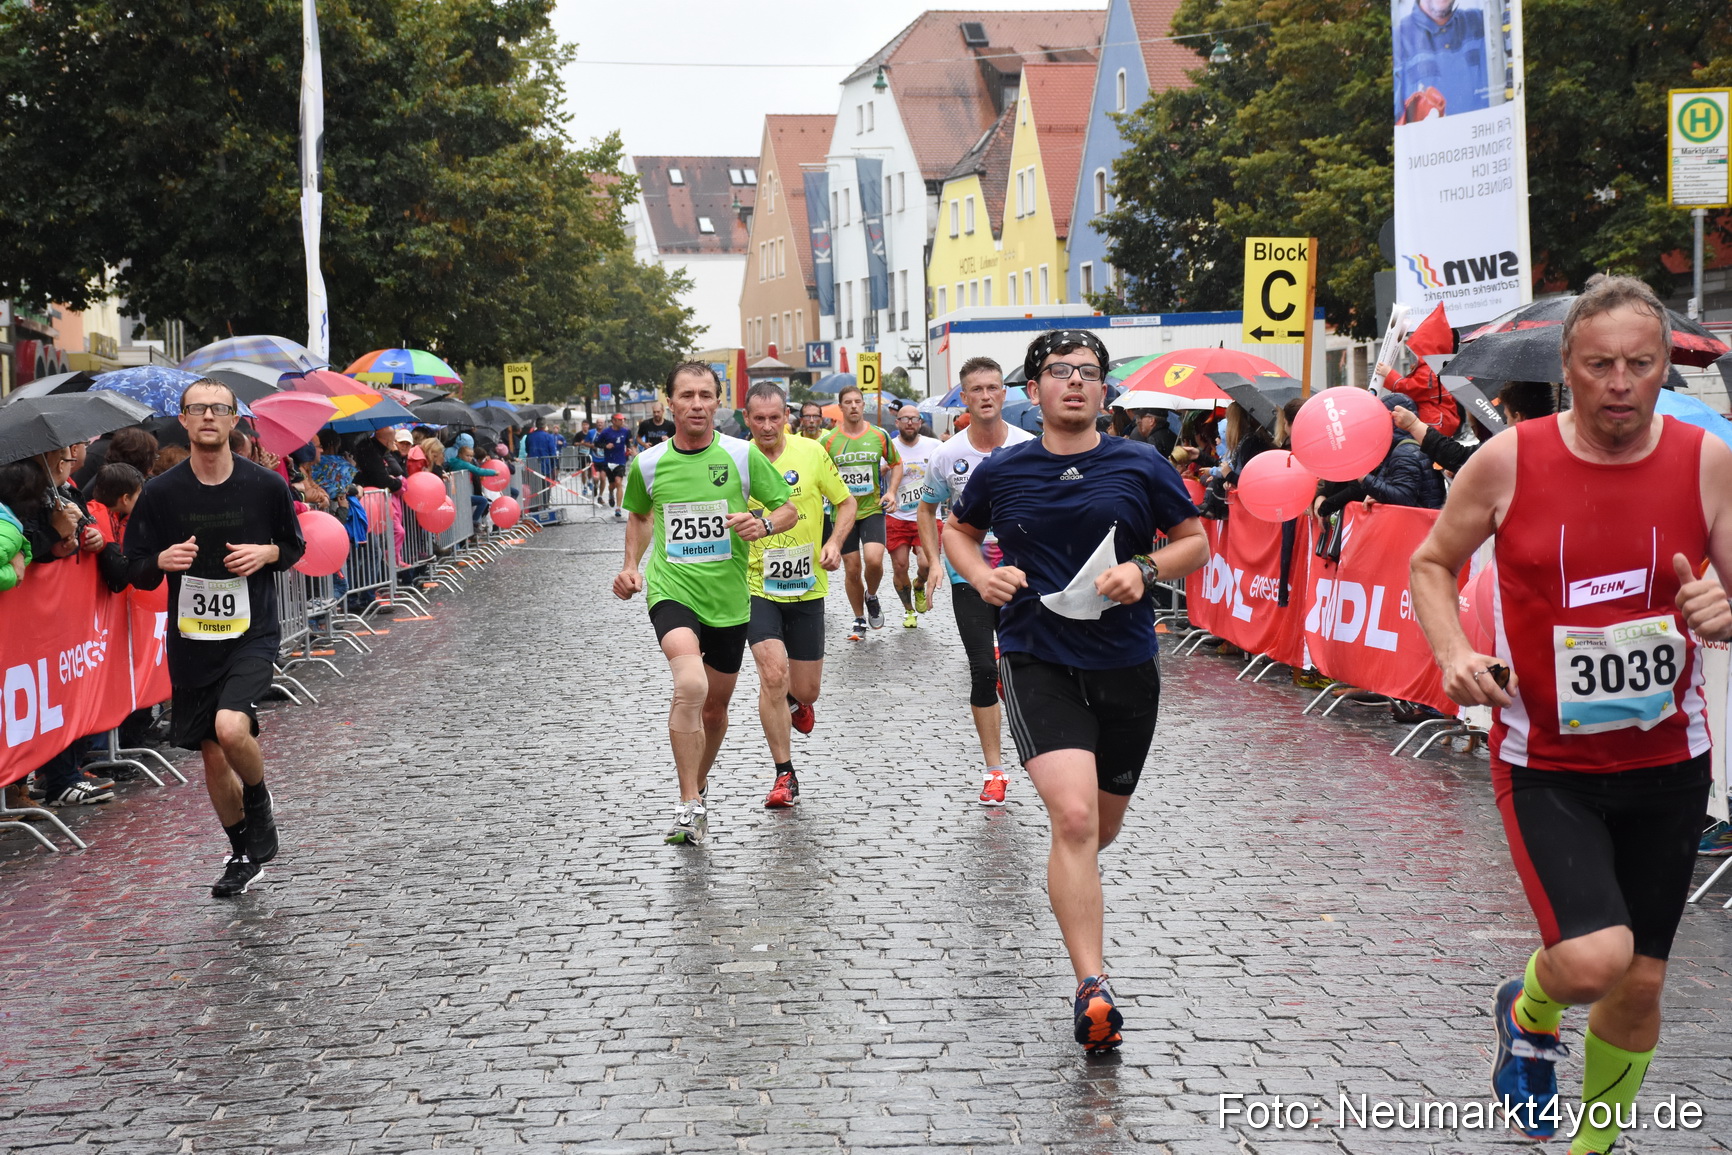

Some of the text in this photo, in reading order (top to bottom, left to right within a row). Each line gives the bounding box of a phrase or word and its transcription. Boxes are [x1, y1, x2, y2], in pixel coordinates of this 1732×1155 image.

[1254, 242, 1308, 261] Block
[960, 256, 977, 275] HOTEL
[1260, 269, 1297, 322] C
[859, 354, 878, 362] Block
[507, 365, 529, 373] Block
[863, 364, 876, 385] D
[512, 375, 526, 395] D
[834, 452, 878, 465] BOCK
[842, 473, 871, 485] 2834
[671, 516, 725, 541] 2553
[682, 544, 715, 555] Herbert
[769, 556, 810, 579] 2845
[777, 580, 809, 590] Helmuth
[1590, 579, 1626, 597] DEHN
[193, 594, 236, 617] 349
[197, 621, 232, 632] Torsten
[1571, 639, 1608, 649] uerMarkt
[1570, 644, 1677, 696] 3038
